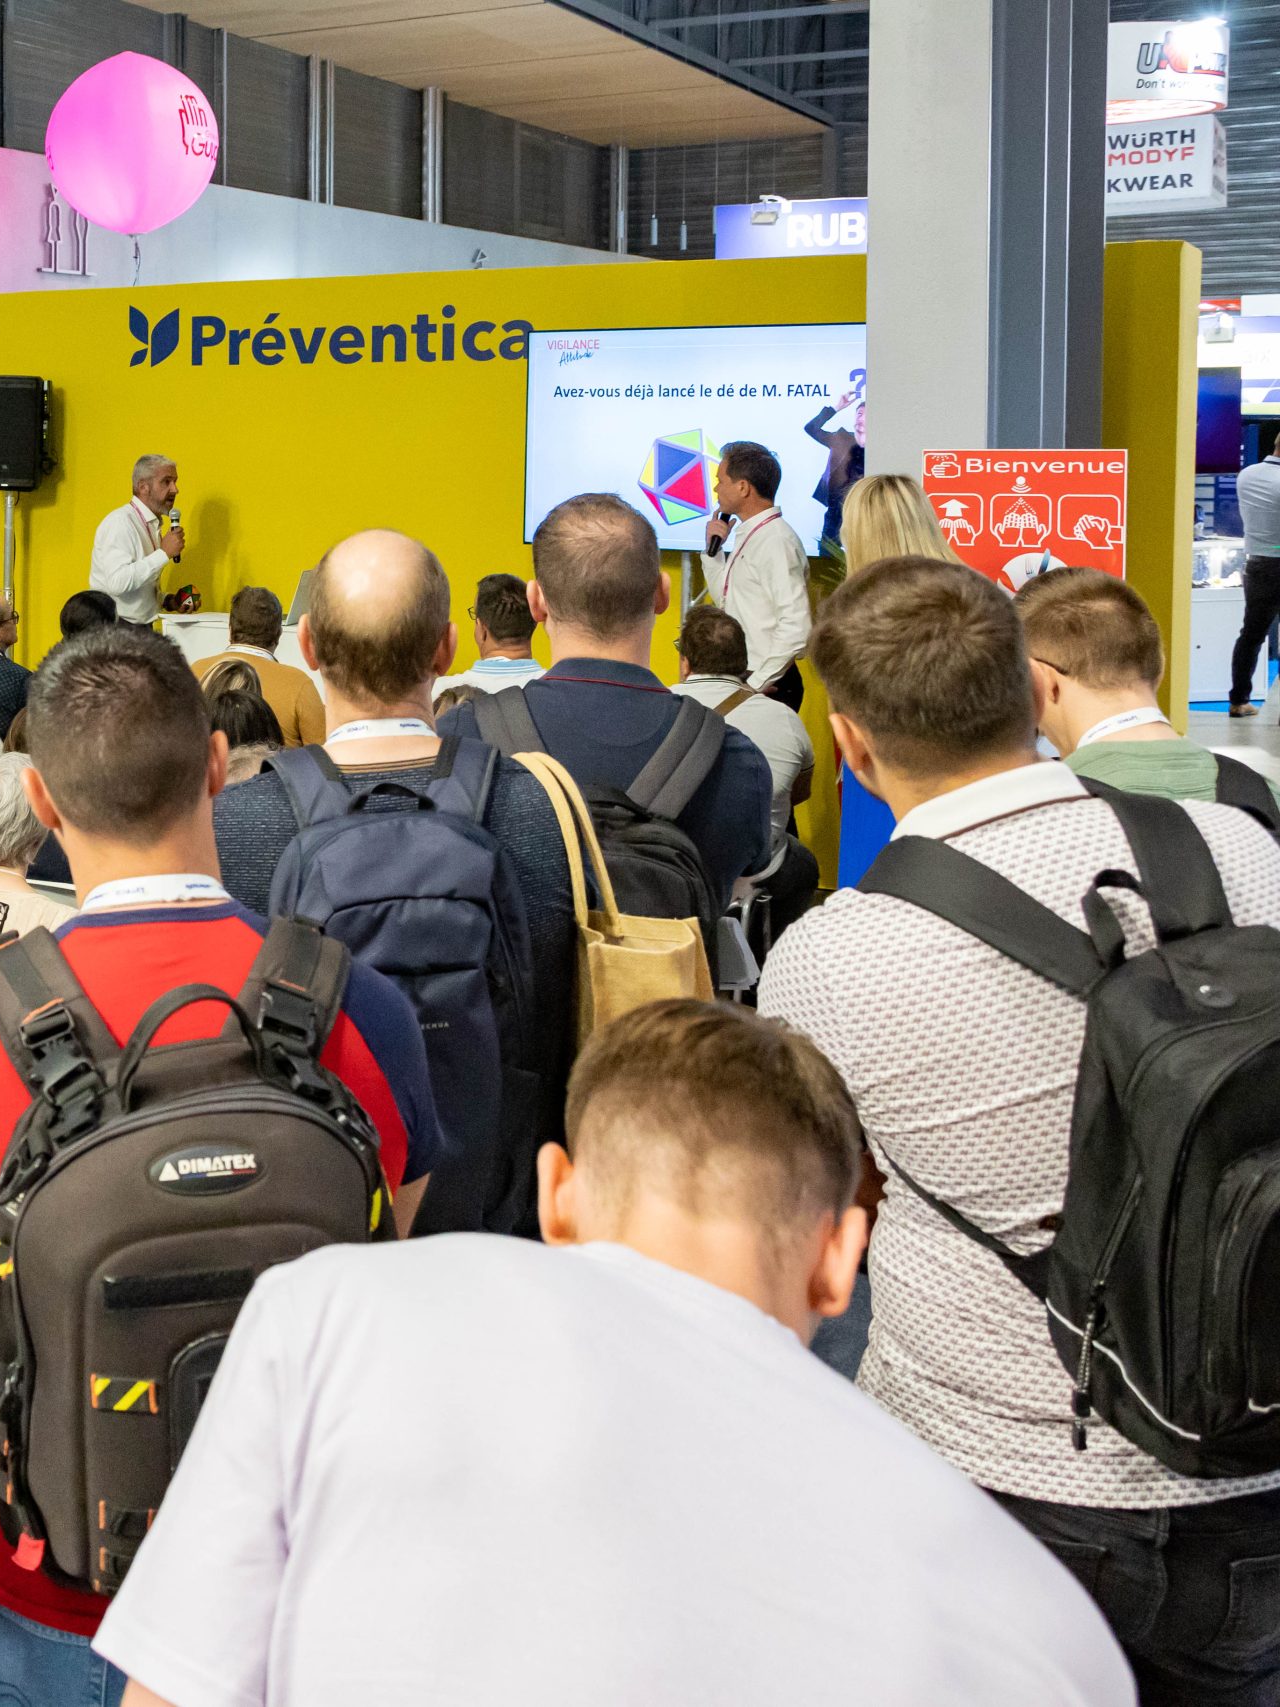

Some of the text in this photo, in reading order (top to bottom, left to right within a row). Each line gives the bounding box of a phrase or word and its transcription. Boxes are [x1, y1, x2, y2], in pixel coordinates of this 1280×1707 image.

[1108, 128, 1195, 150] WÜRTH
[1108, 146, 1195, 167] MODYF
[1107, 173, 1193, 193] KWEAR
[786, 211, 866, 248] RUB
[191, 304, 534, 367] Préventica
[547, 339, 600, 351] VIGILANCE
[553, 383, 831, 401] Avez-vous déjà lancé le dé de M. FATAL
[966, 458, 1124, 474] Bienvenue
[177, 1153, 257, 1175] DIMATEX
